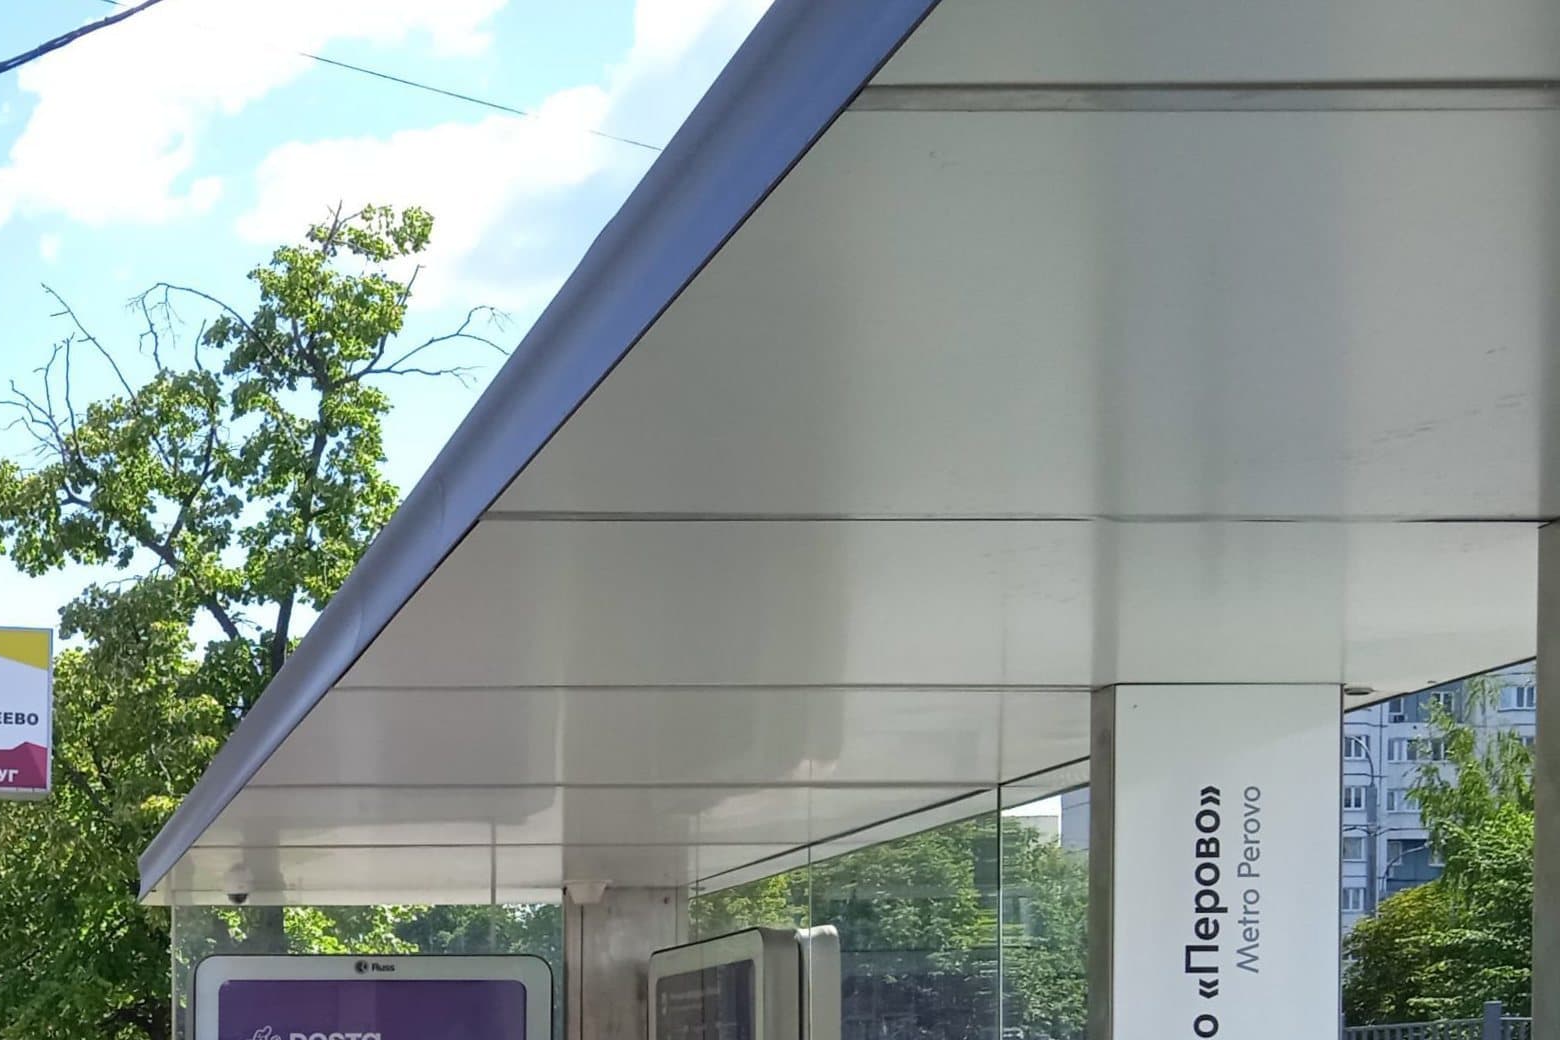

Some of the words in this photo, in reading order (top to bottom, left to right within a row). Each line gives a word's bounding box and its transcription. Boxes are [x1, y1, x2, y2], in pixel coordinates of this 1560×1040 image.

[1237, 785, 1261, 879] Perovo
[1184, 785, 1228, 999] «Перово»
[1236, 888, 1261, 974] Metro
